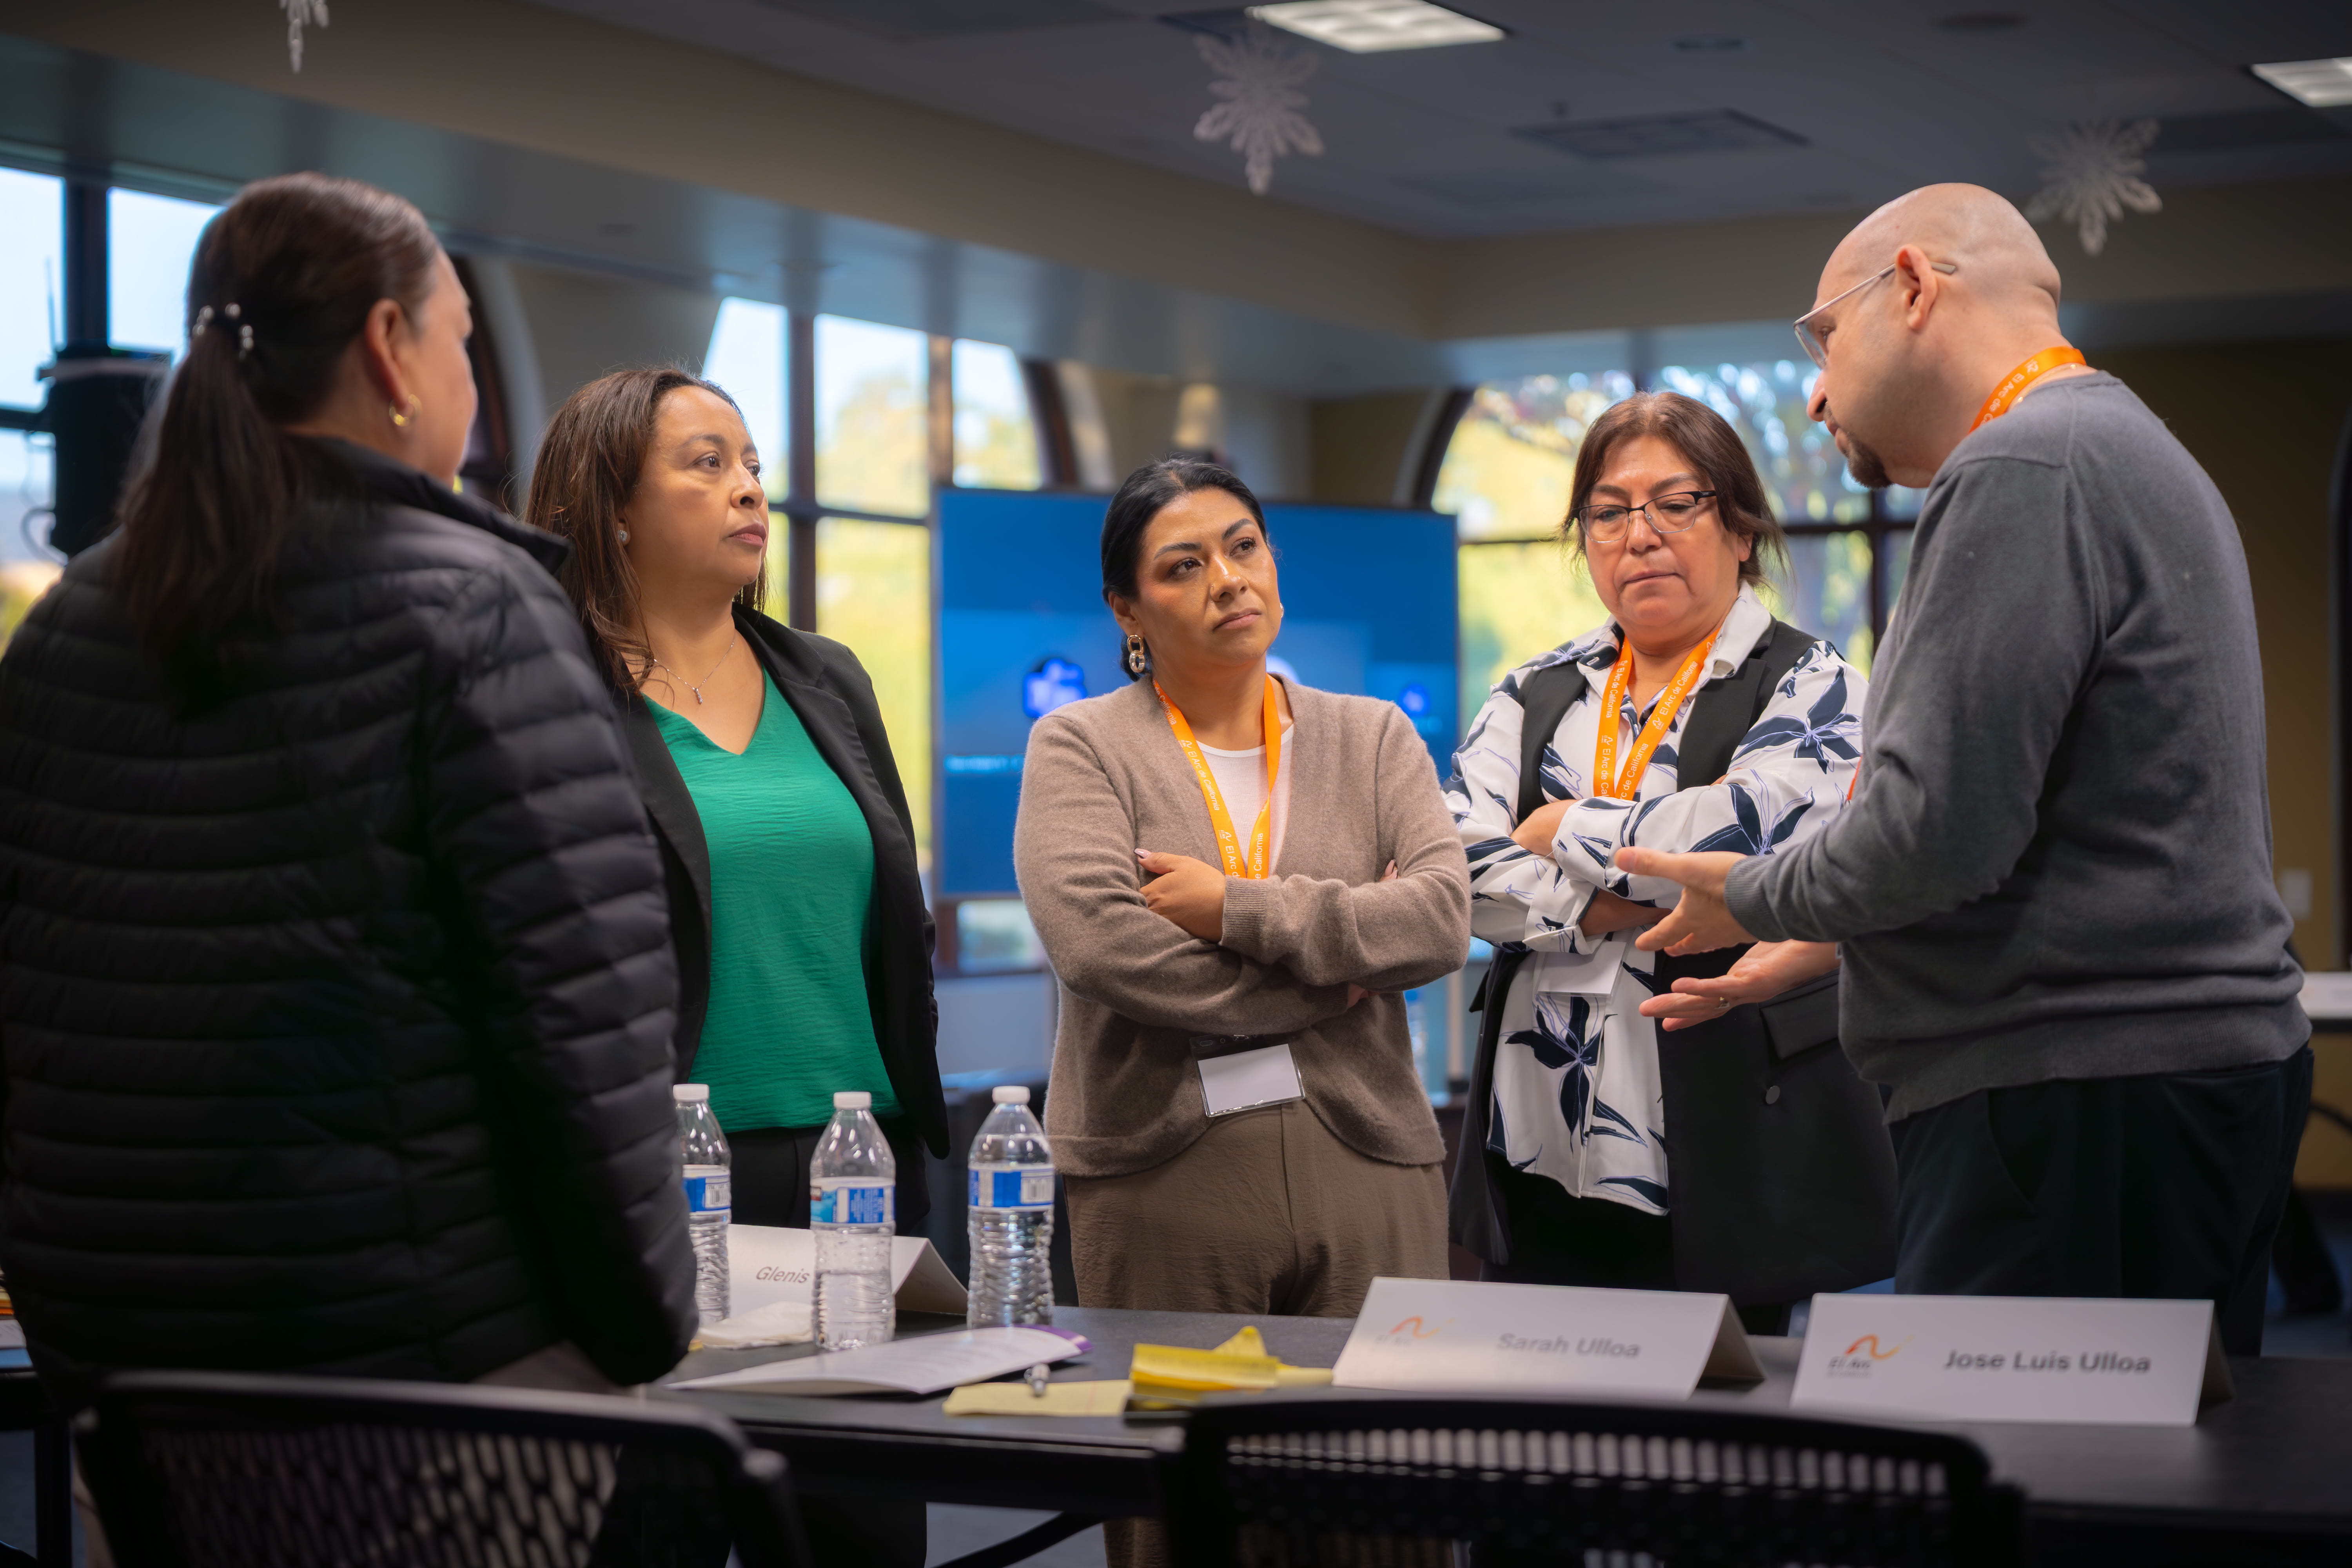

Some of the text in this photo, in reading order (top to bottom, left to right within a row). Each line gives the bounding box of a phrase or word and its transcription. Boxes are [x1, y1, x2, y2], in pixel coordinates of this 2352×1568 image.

[2012, 373, 2025, 383] El
[1998, 381, 2014, 398] Arc
[1989, 398, 2001, 412] de
[1613, 673, 1623, 681] Arc
[1659, 706, 1669, 715] El
[1664, 695, 1676, 708] Arc
[1672, 686, 1681, 695] de
[1677, 661, 1698, 686] California
[1158, 695, 1177, 725] California
[1606, 690, 1618, 718] California
[1601, 756, 1610, 768] Arc
[1622, 780, 1632, 790] de
[1627, 743, 1649, 777] California
[1192, 758, 1201, 769] Arc
[1203, 779, 1220, 810] California
[1601, 770, 1609, 780] de
[1228, 855, 1236, 869] Arc
[1254, 833, 1263, 871] California
[755, 1266, 810, 1283] Glenis
[1497, 1332, 1641, 1358] Sarah Ulloa
[1945, 1349, 2152, 1372] Jose Luis Ulloa
